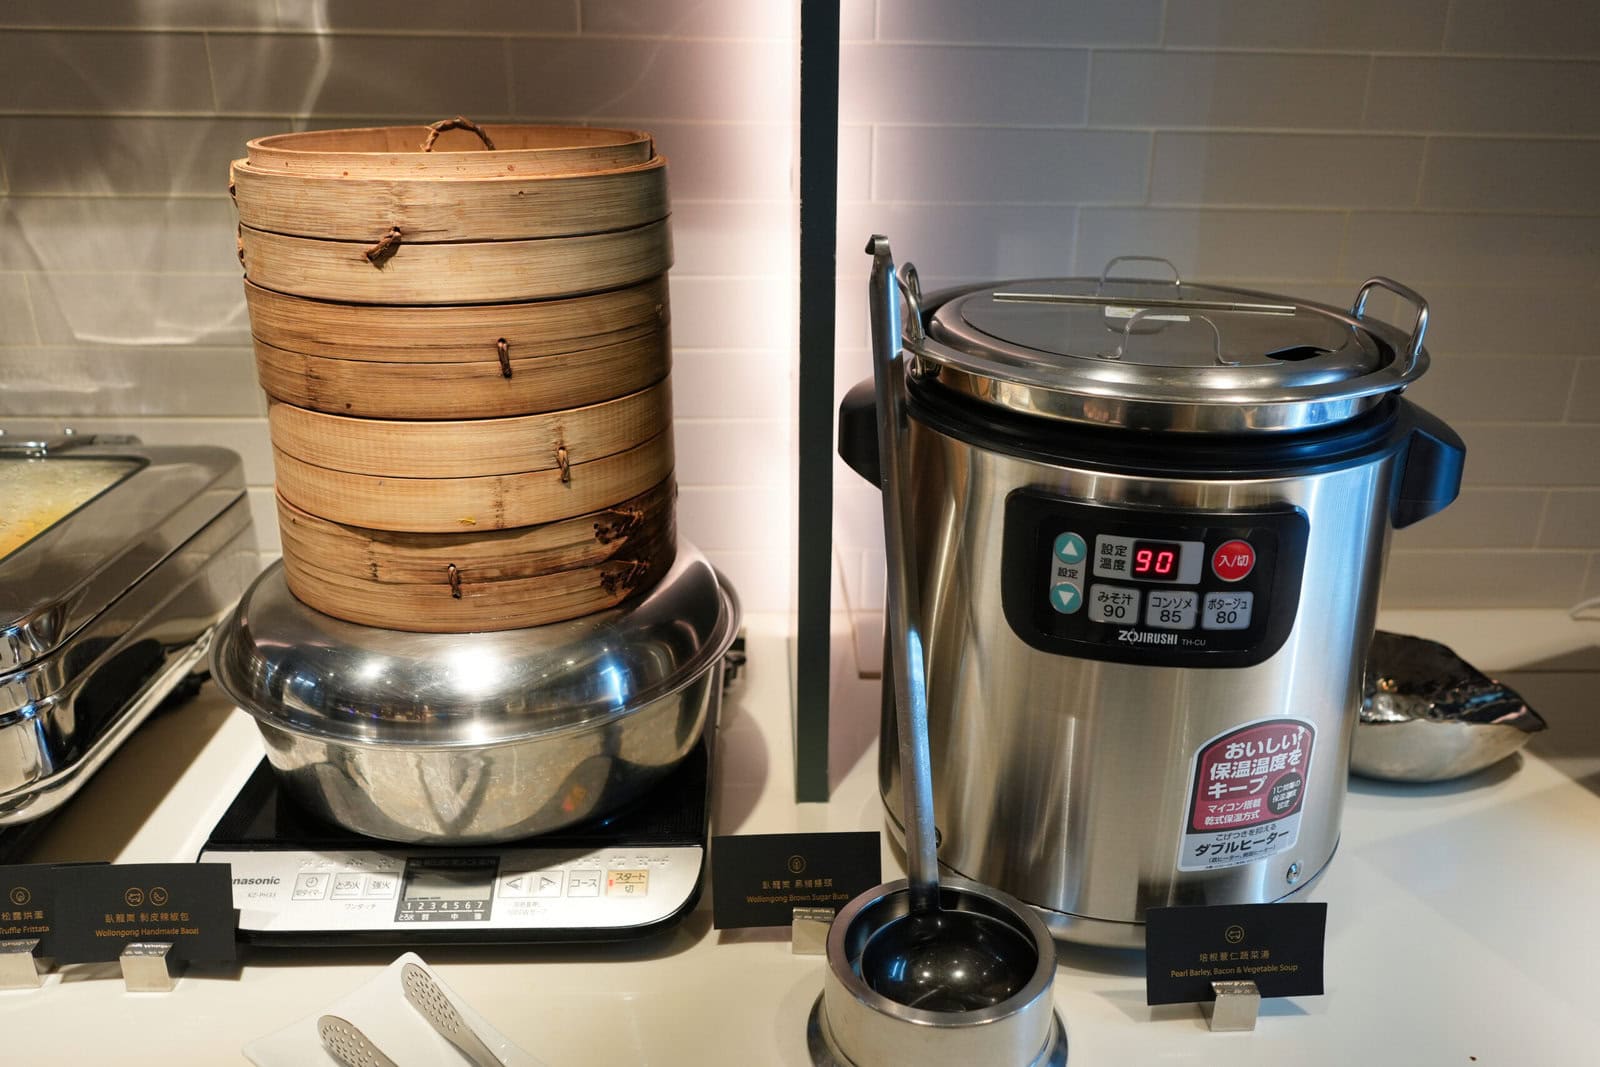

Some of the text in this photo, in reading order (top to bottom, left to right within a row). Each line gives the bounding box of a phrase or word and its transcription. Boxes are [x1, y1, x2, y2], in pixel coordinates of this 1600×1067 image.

[1101, 543, 1128, 557] 設定
[1100, 558, 1126, 571] 温度
[1135, 550, 1174, 573] 90
[1218, 555, 1250, 568] 入/切
[1057, 567, 1079, 579] 設定
[1097, 592, 1134, 605] みそ汁
[1152, 597, 1193, 609] コンソメ
[1103, 605, 1125, 619] 90
[1160, 610, 1182, 623] 85
[1216, 611, 1238, 624] 80
[1118, 629, 1206, 646] ZOJIRUSHI TH-CU
[1225, 733, 1299, 759] おいしい
[1210, 750, 1302, 781] 保温温度を
[1207, 775, 1267, 799] キープ
[1195, 831, 1289, 856] ダブルヒーター
[232, 876, 280, 885] nasonic
[571, 878, 598, 888] コース
[615, 872, 645, 881] スタート
[625, 885, 634, 893] 切
[746, 894, 788, 903] Wollongong
[812, 893, 832, 902] Sugar
[450, 913, 459, 921] 中
[23, 925, 50, 933] Frittata
[95, 928, 140, 937] Wollongong
[141, 927, 180, 935] Handmade
[1170, 969, 1189, 978] Pearl
[1213, 966, 1236, 975] Bacon
[1242, 964, 1279, 975] Vegetable
[1279, 963, 1298, 973] Soup
